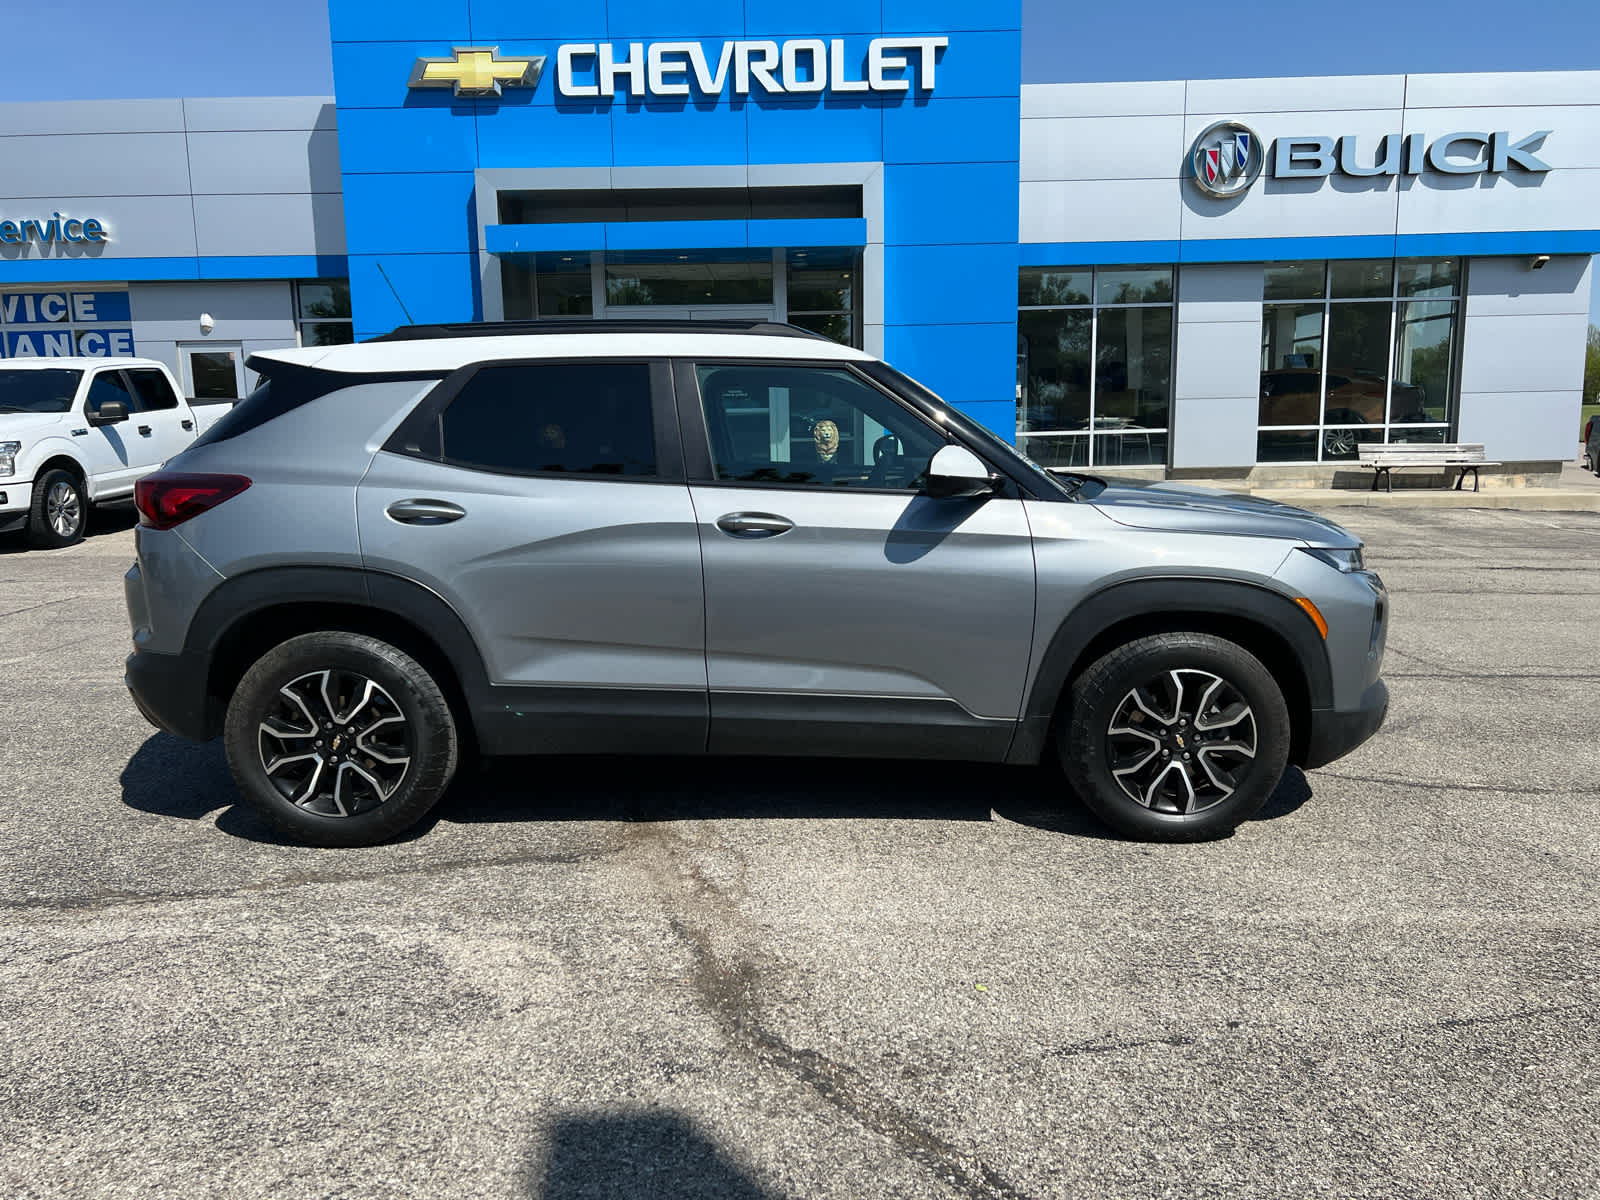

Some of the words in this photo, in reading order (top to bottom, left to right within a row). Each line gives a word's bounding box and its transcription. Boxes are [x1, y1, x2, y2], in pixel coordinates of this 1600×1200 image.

[557, 36, 949, 97] CHEVROLET
[1273, 130, 1553, 179] BUICK
[0, 211, 103, 242] ervice
[0, 332, 133, 357] ANCE
